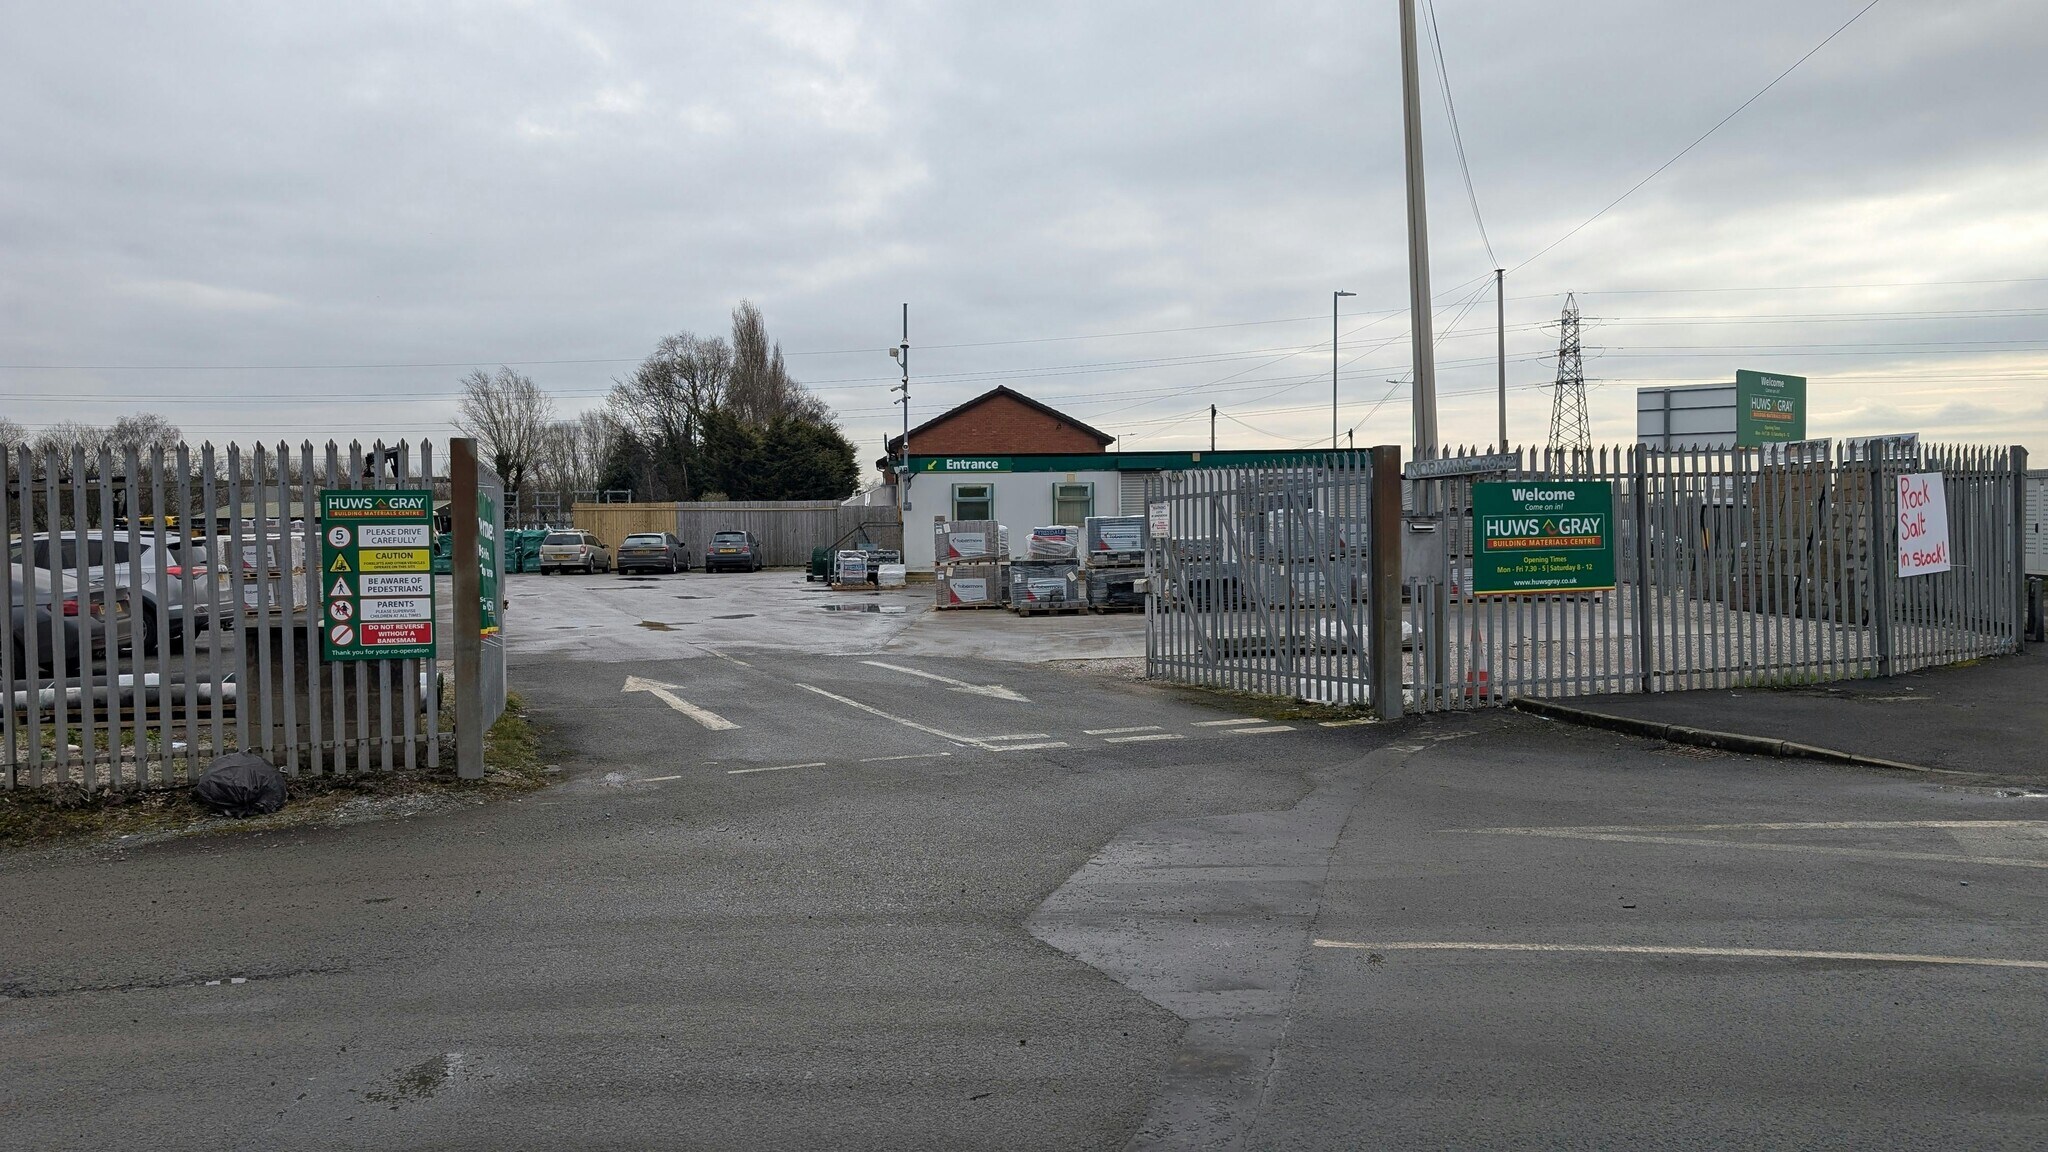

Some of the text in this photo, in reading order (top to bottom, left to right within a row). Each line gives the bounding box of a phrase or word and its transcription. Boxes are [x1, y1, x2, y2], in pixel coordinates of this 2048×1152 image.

[1760, 376, 1784, 388] Welcome
[1751, 397, 1794, 412] HUWS GRAY
[946, 459, 999, 470] Entrance
[1410, 459, 1472, 476] NORMANS
[1512, 488, 1576, 501] Welcome
[1901, 478, 1930, 509] Rock
[329, 498, 424, 509] HUWS GRAY
[1486, 518, 1600, 536] HUWS GRAY
[1901, 512, 1926, 540] Salt
[336, 530, 343, 540] 5
[1900, 541, 1947, 568] in stock!
[1514, 577, 1577, 586] www.huwsgray.co.uk
